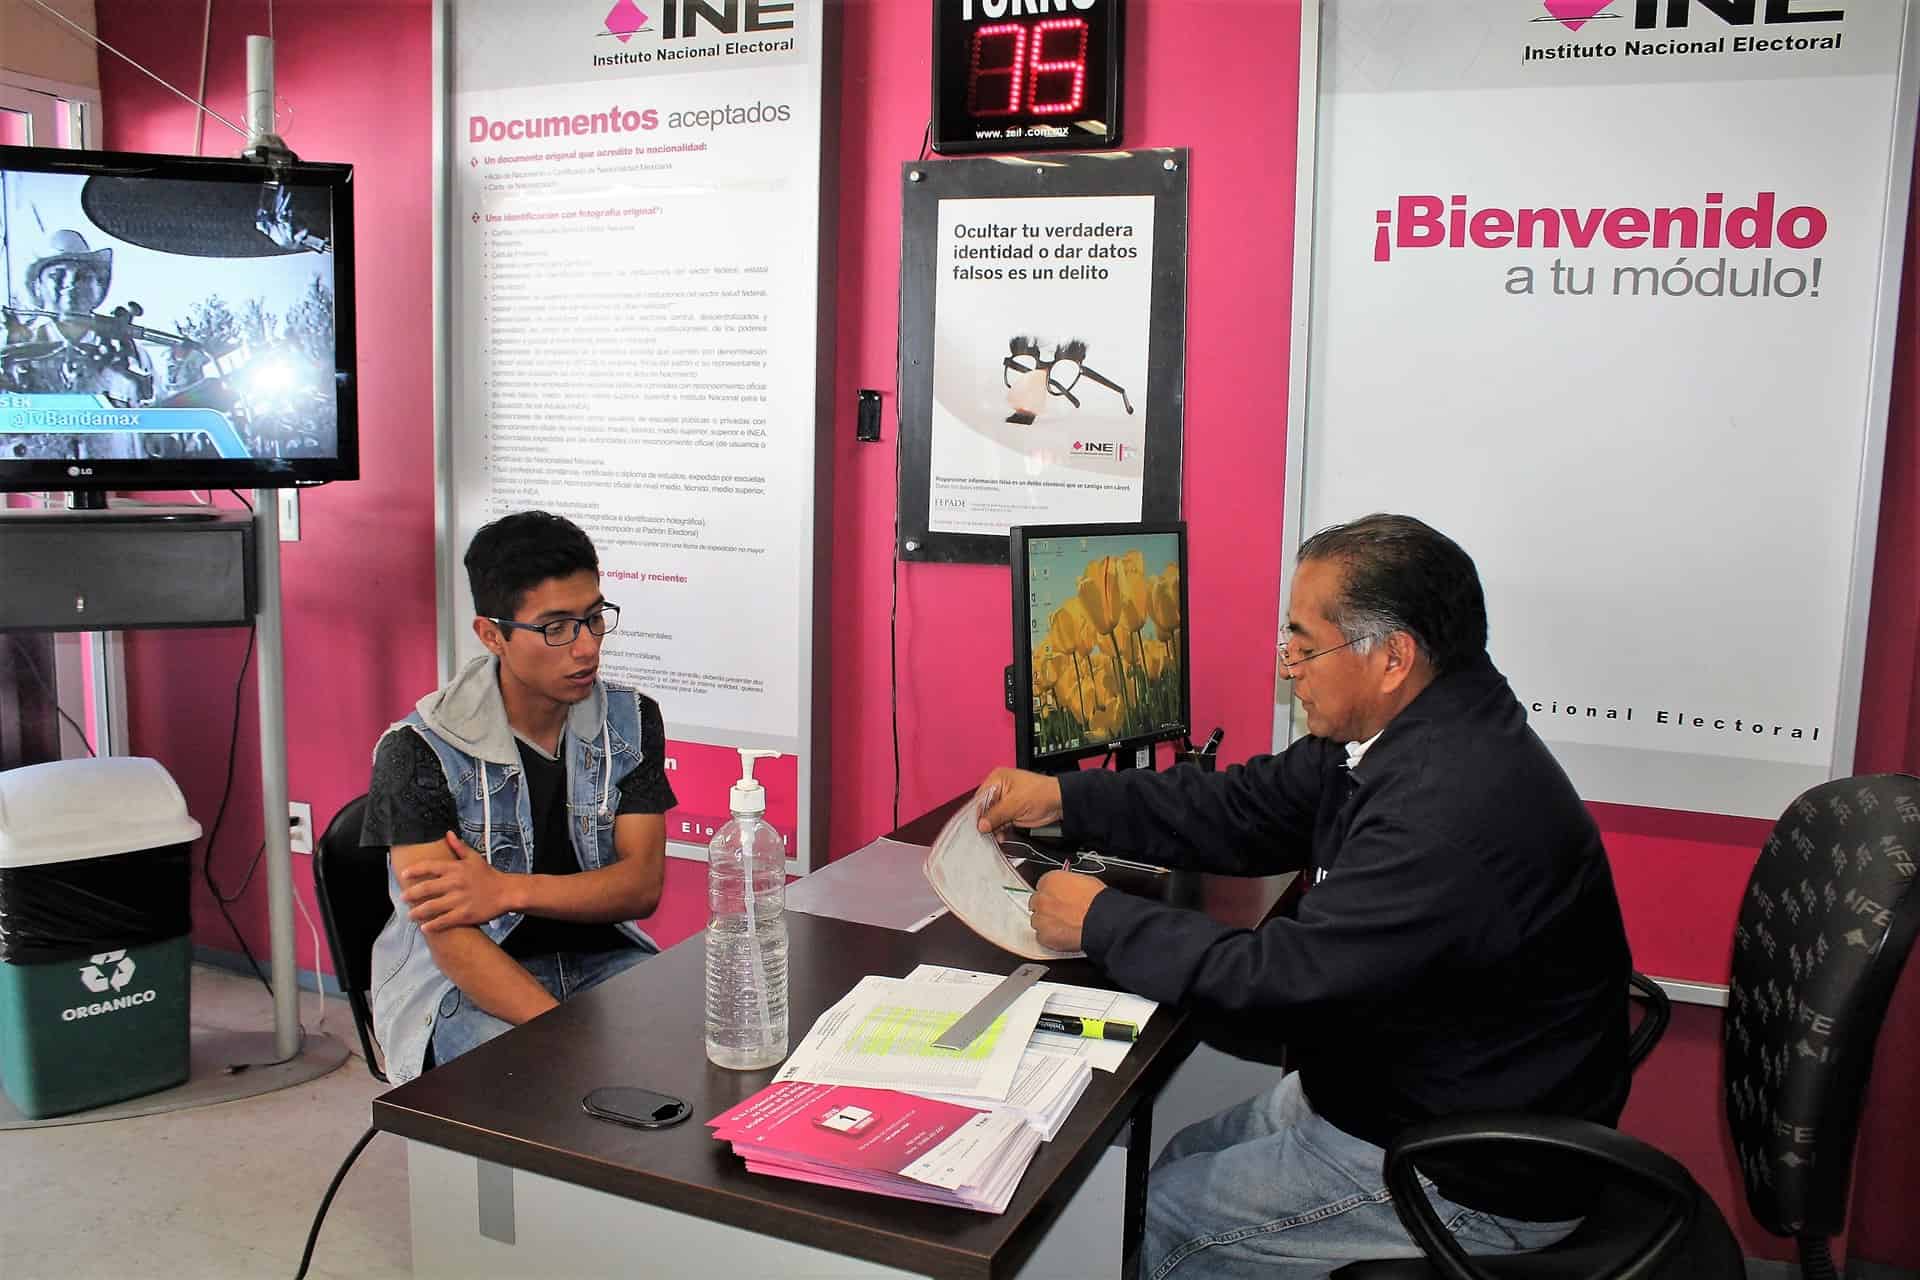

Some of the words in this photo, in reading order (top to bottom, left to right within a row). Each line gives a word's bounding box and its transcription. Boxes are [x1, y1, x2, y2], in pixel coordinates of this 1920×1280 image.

[593, 53, 651, 66] Instituto
[657, 44, 719, 60] Nacional
[726, 38, 793, 54] Electoral
[1525, 43, 1616, 60] Instituto
[1625, 38, 1724, 56] Nacional
[1733, 33, 1841, 51] Electoral
[469, 105, 659, 143] Documentos
[668, 101, 791, 131] aceptados
[954, 224, 1017, 239] Ocultar
[1023, 224, 1039, 238] tu
[1046, 222, 1133, 238] verdadera
[1374, 192, 1827, 262] ¡Bienvenido
[954, 244, 1033, 260] identidad
[1039, 249, 1049, 259] o
[1054, 243, 1083, 259] dar
[1088, 243, 1137, 258] datos
[953, 265, 1002, 280] falsos
[1008, 268, 1027, 280] es
[1033, 268, 1053, 280] un
[1059, 265, 1108, 280] delito
[1505, 267, 1534, 296] a
[1551, 259, 1595, 296] tu
[1614, 256, 1822, 298] módulo!
[1085, 443, 1113, 452] INE
[607, 570, 638, 583] original
[1532, 701, 1633, 722] cional
[1657, 710, 1820, 742] Electoral
[61, 990, 157, 1022] ORGANICO
